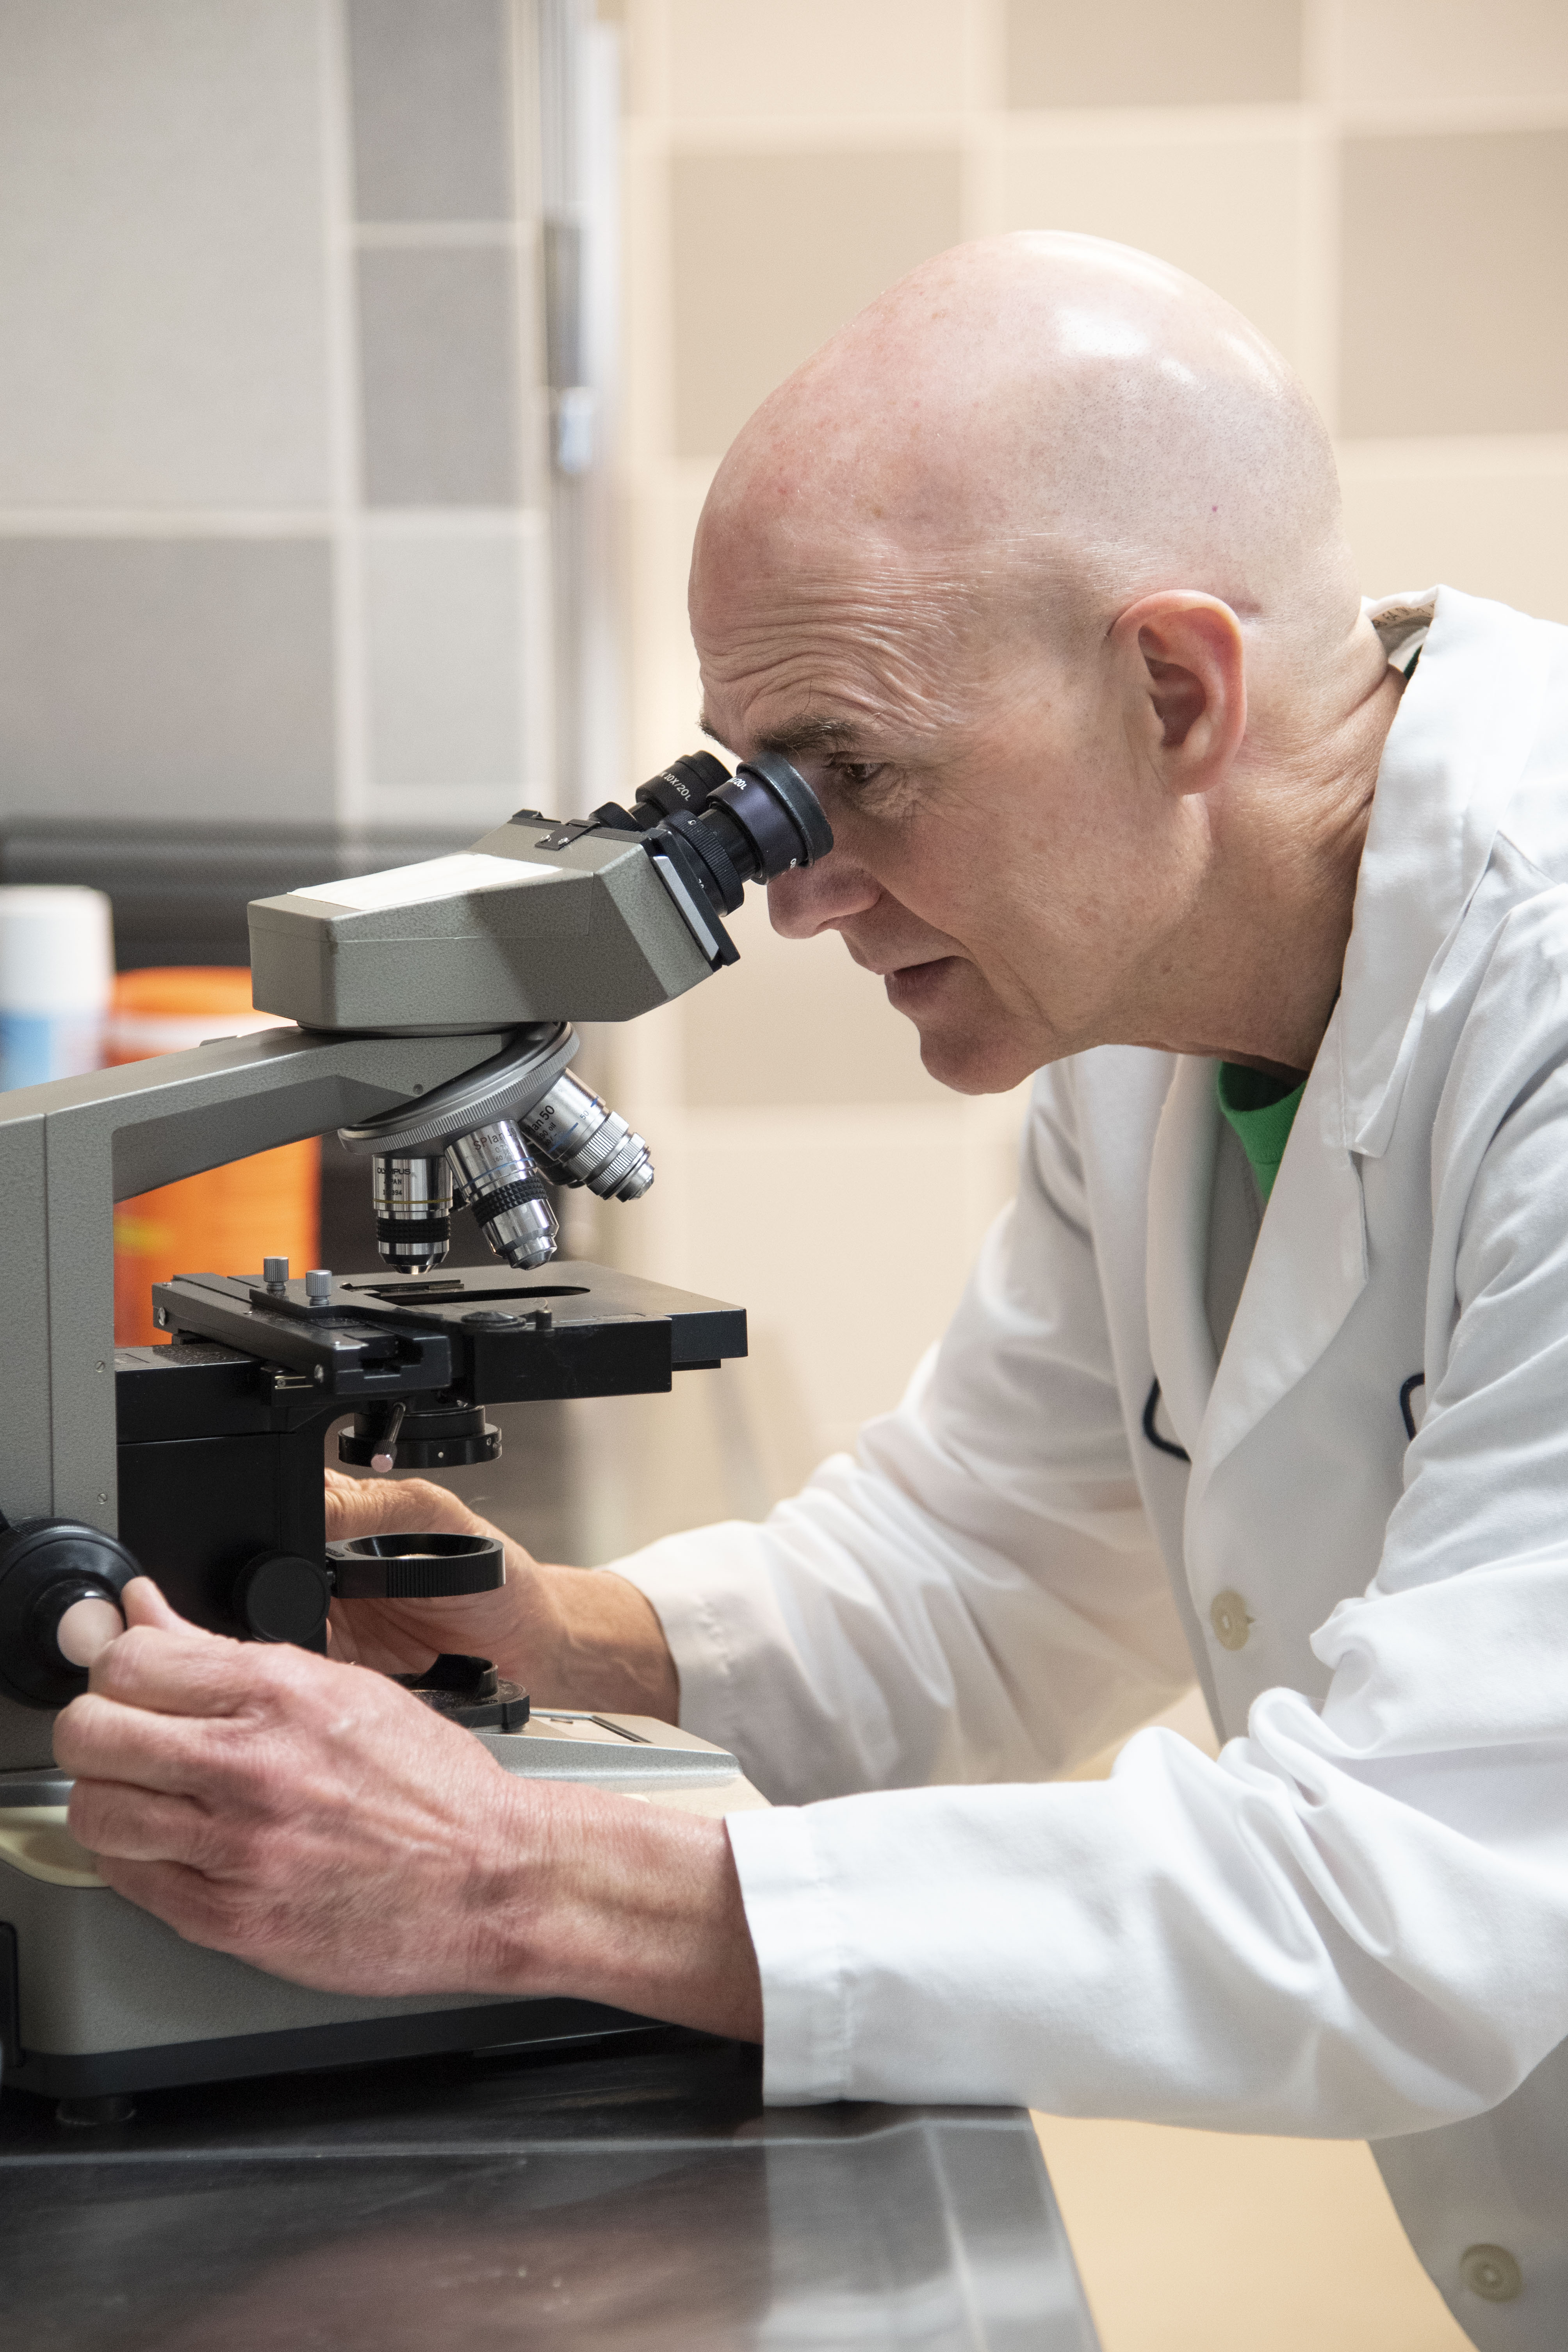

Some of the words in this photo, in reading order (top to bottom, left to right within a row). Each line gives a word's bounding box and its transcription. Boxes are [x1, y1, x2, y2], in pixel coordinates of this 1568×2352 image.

[539, 1105, 555, 1120] 50
[579, 1110, 589, 1120] 50
[473, 1133, 506, 1150] SPlan
